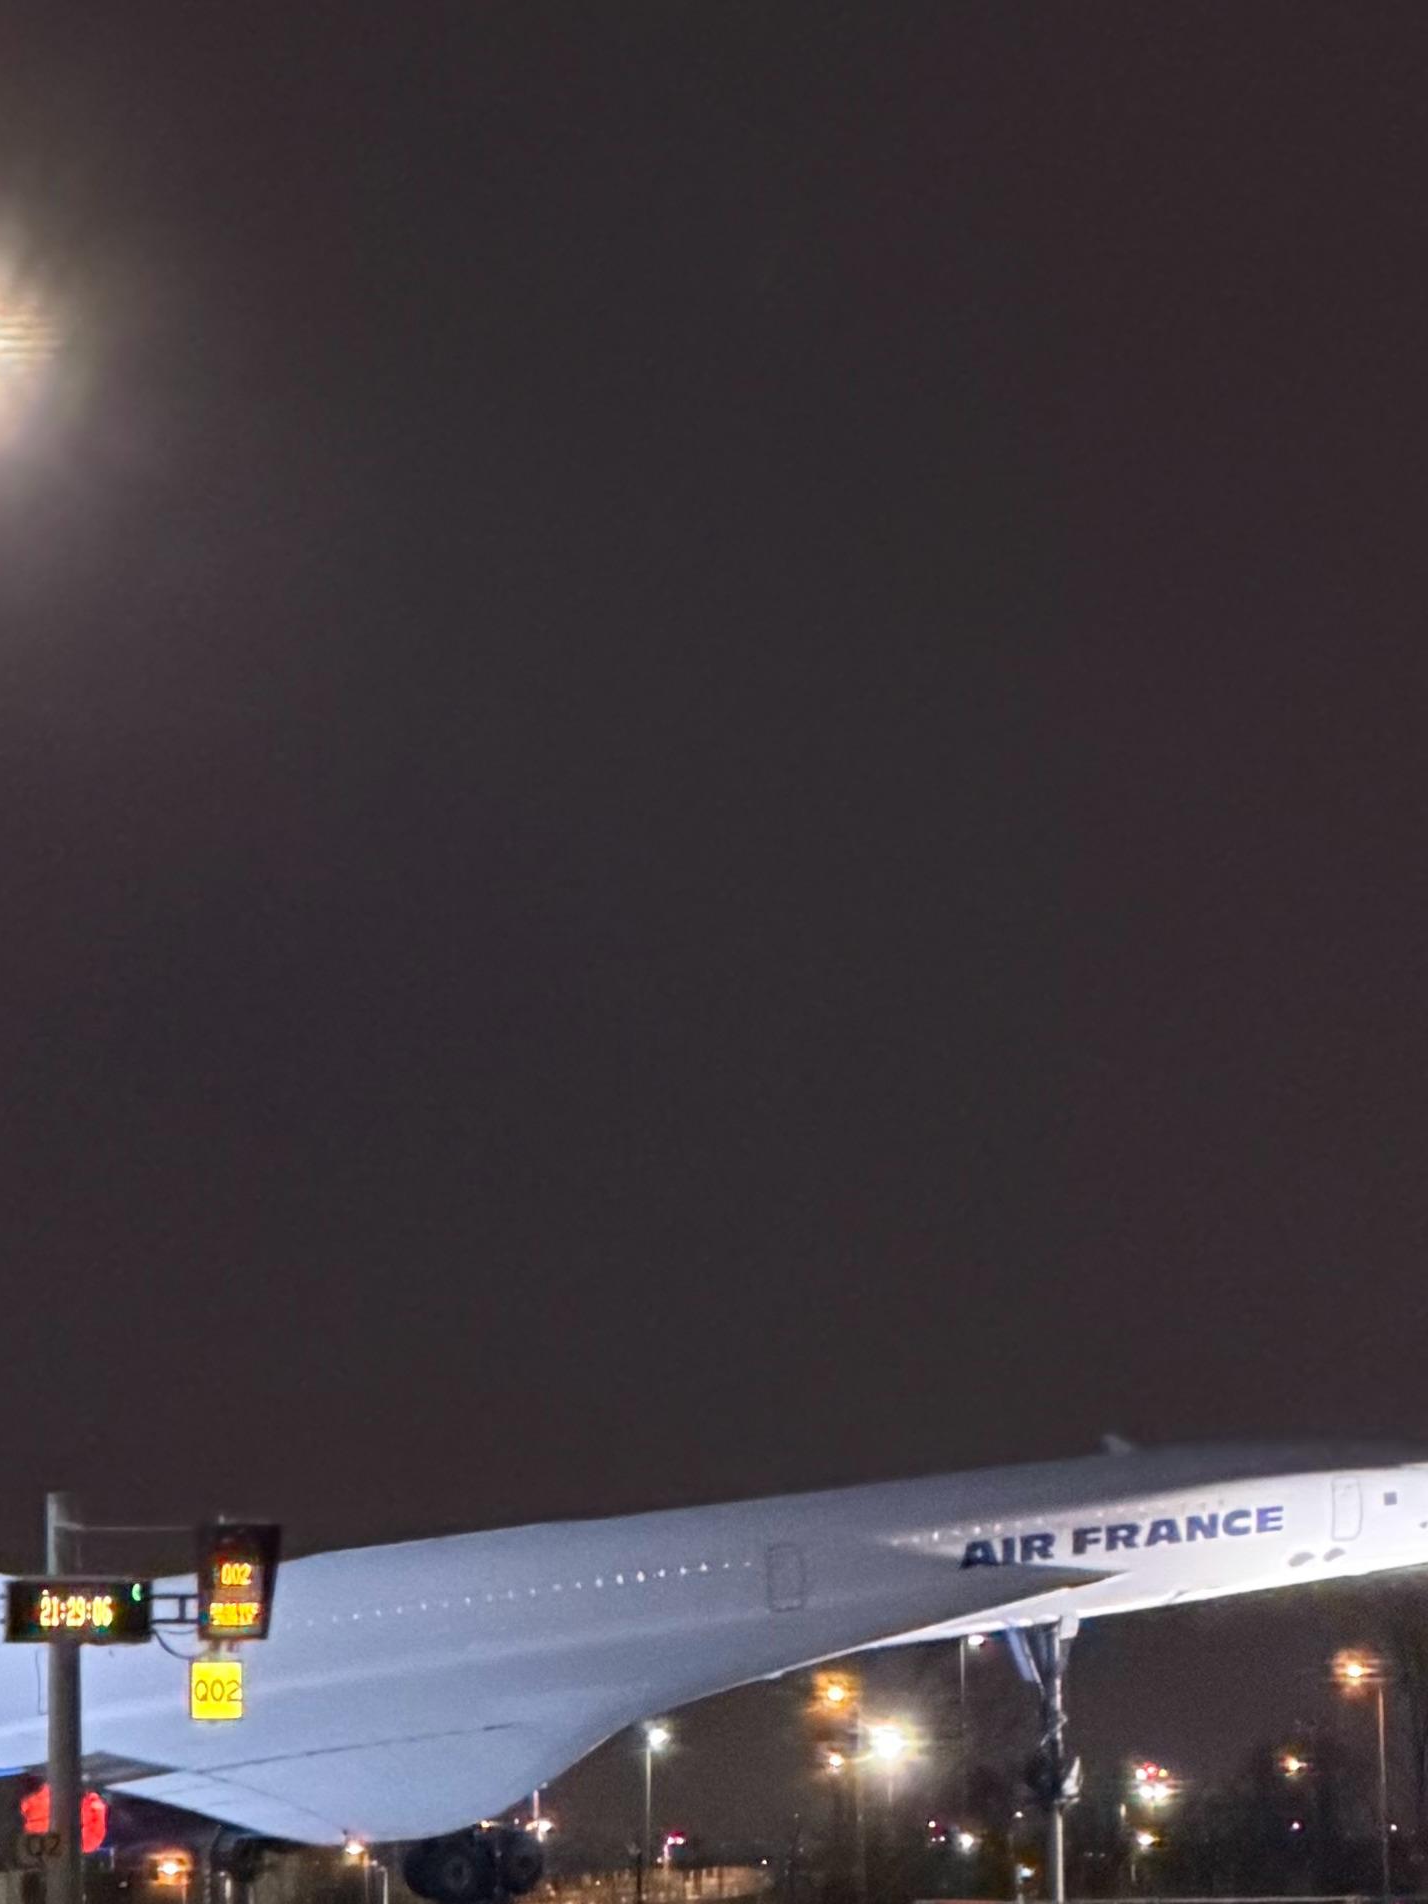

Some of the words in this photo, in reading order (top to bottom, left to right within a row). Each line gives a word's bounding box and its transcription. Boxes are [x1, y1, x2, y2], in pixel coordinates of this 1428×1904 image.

[959, 1533, 1056, 1570] AIR
[1072, 1506, 1284, 1555] FRANCE
[194, 1680, 243, 1702] Q02
